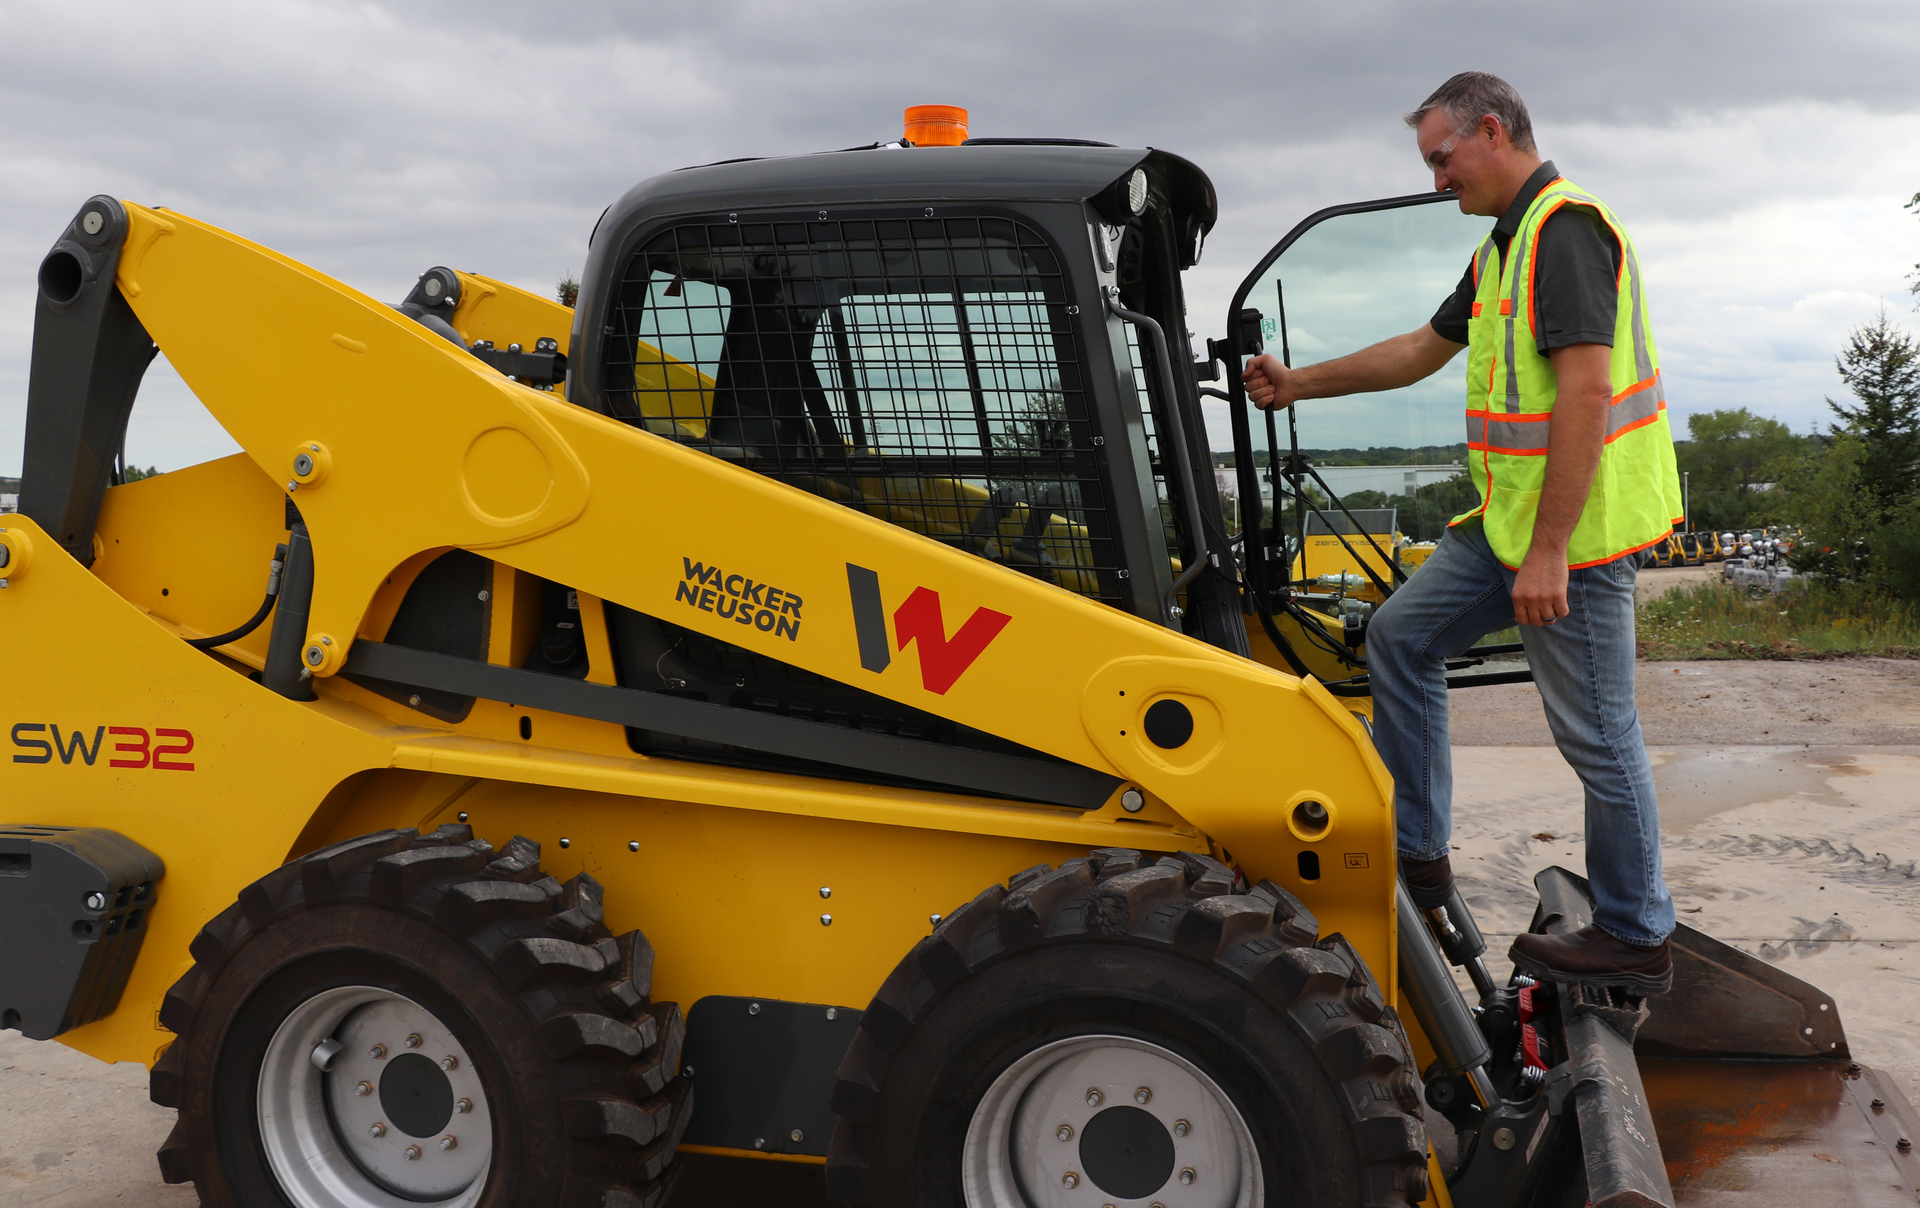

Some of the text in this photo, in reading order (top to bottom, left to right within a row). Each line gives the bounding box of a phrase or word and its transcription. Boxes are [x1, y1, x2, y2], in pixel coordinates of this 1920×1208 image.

[675, 580, 800, 641] NEUSON
[683, 556, 803, 618] WACKER
[11, 723, 195, 772] SW32
[330, 909, 447, 971] CAMSO
